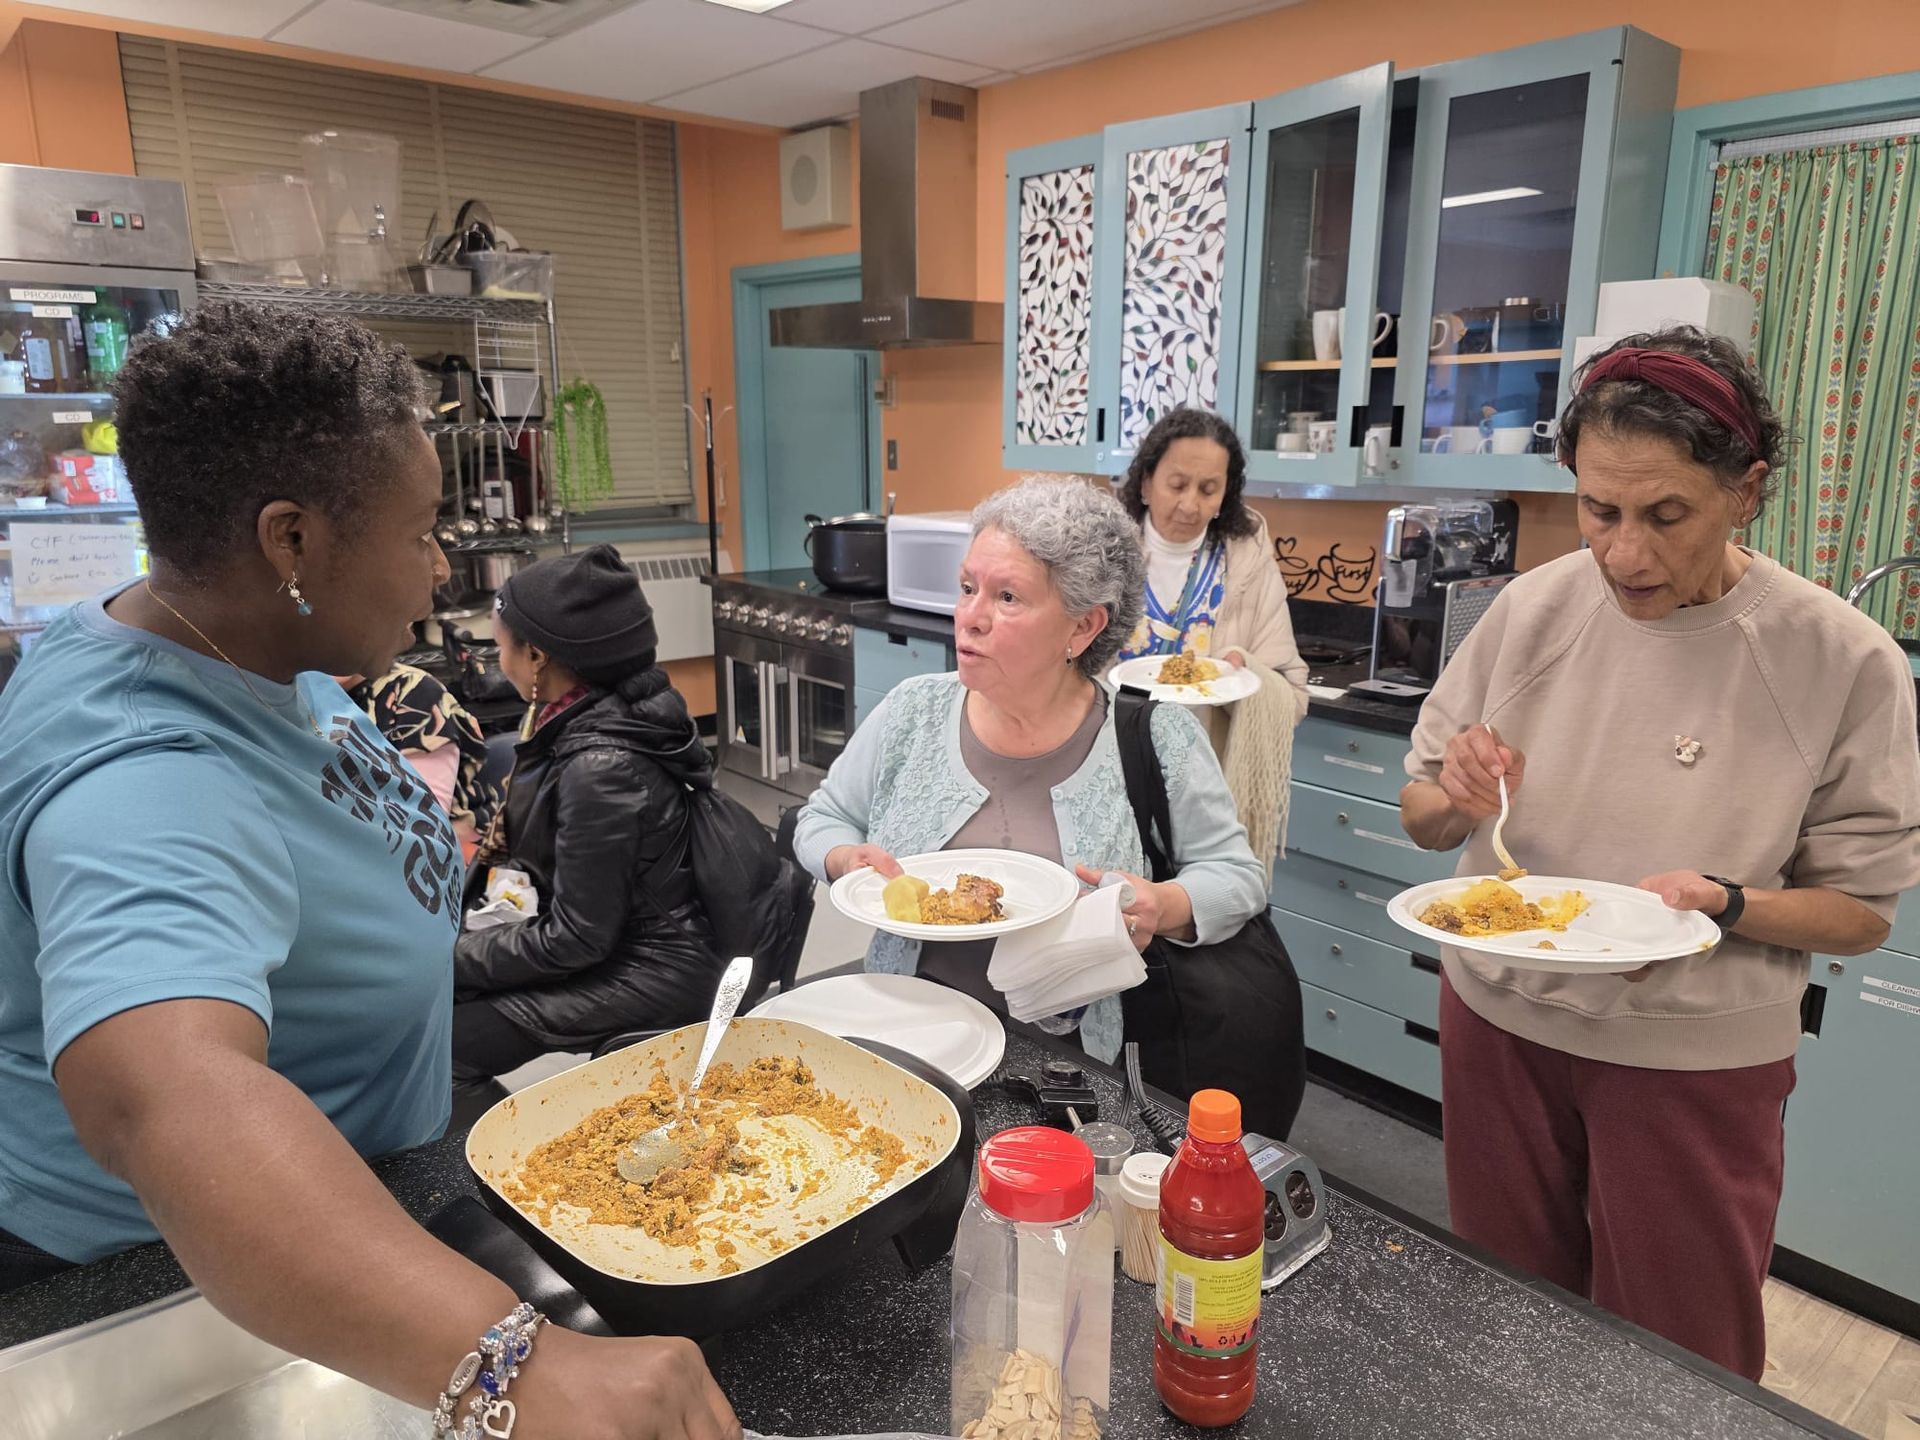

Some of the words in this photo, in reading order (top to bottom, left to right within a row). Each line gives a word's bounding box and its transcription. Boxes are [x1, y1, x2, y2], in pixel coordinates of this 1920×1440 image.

[23, 290, 84, 301] PROGRAMS
[44, 307, 60, 316] CD
[65, 413, 80, 422] CD
[453, 1359, 477, 1390] Dream
